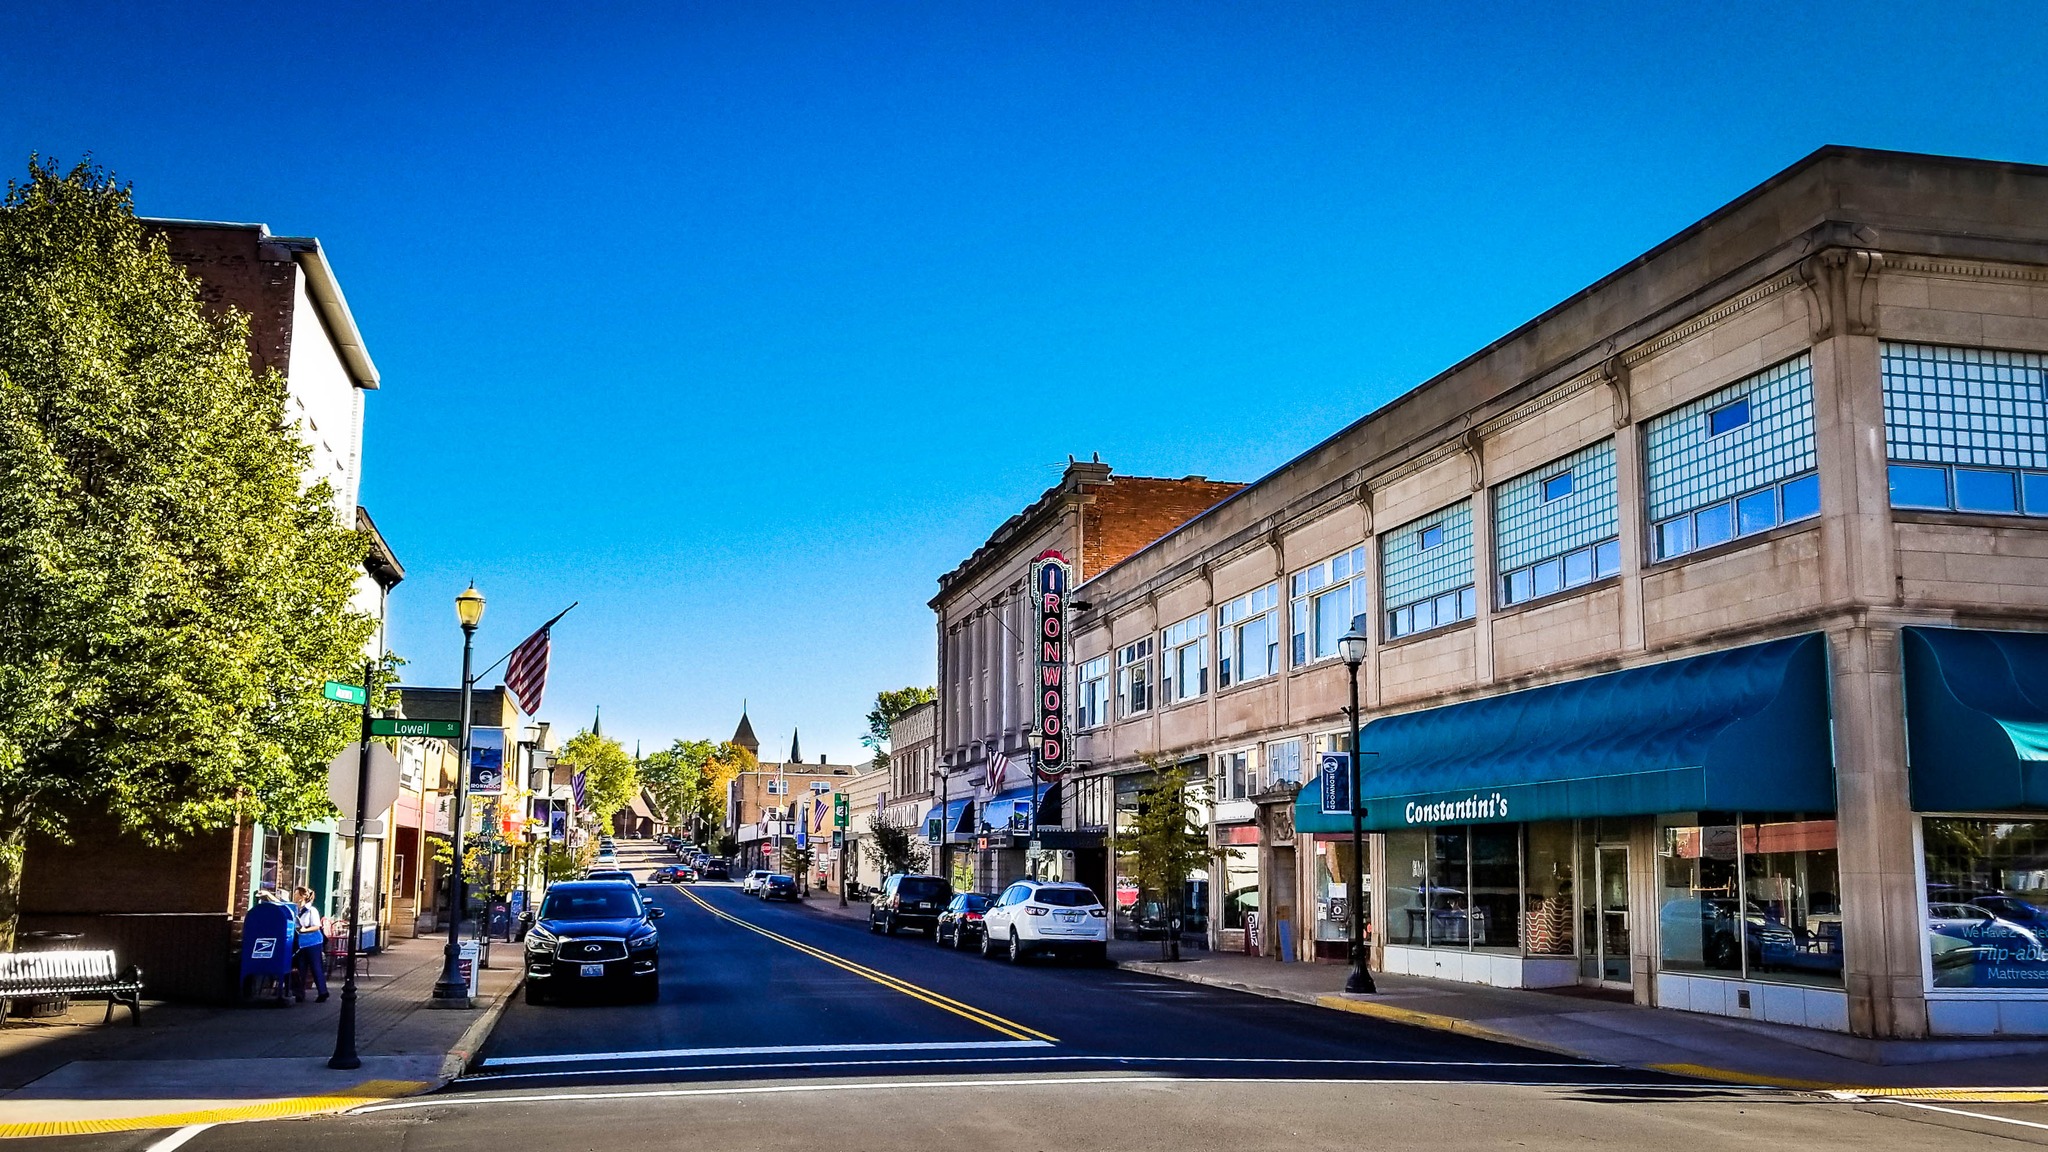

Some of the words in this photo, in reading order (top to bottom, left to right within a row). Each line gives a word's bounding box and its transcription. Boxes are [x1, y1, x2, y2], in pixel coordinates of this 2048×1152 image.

[1043, 568, 1061, 760] IRONWOOD
[394, 721, 430, 735] Lowell
[1405, 792, 1508, 824] Constantini's
[1247, 915, 1259, 947] OPEN
[1962, 926, 1980, 938] We
[1981, 926, 2007, 938] Have
[1979, 943, 2048, 965] Flip-able
